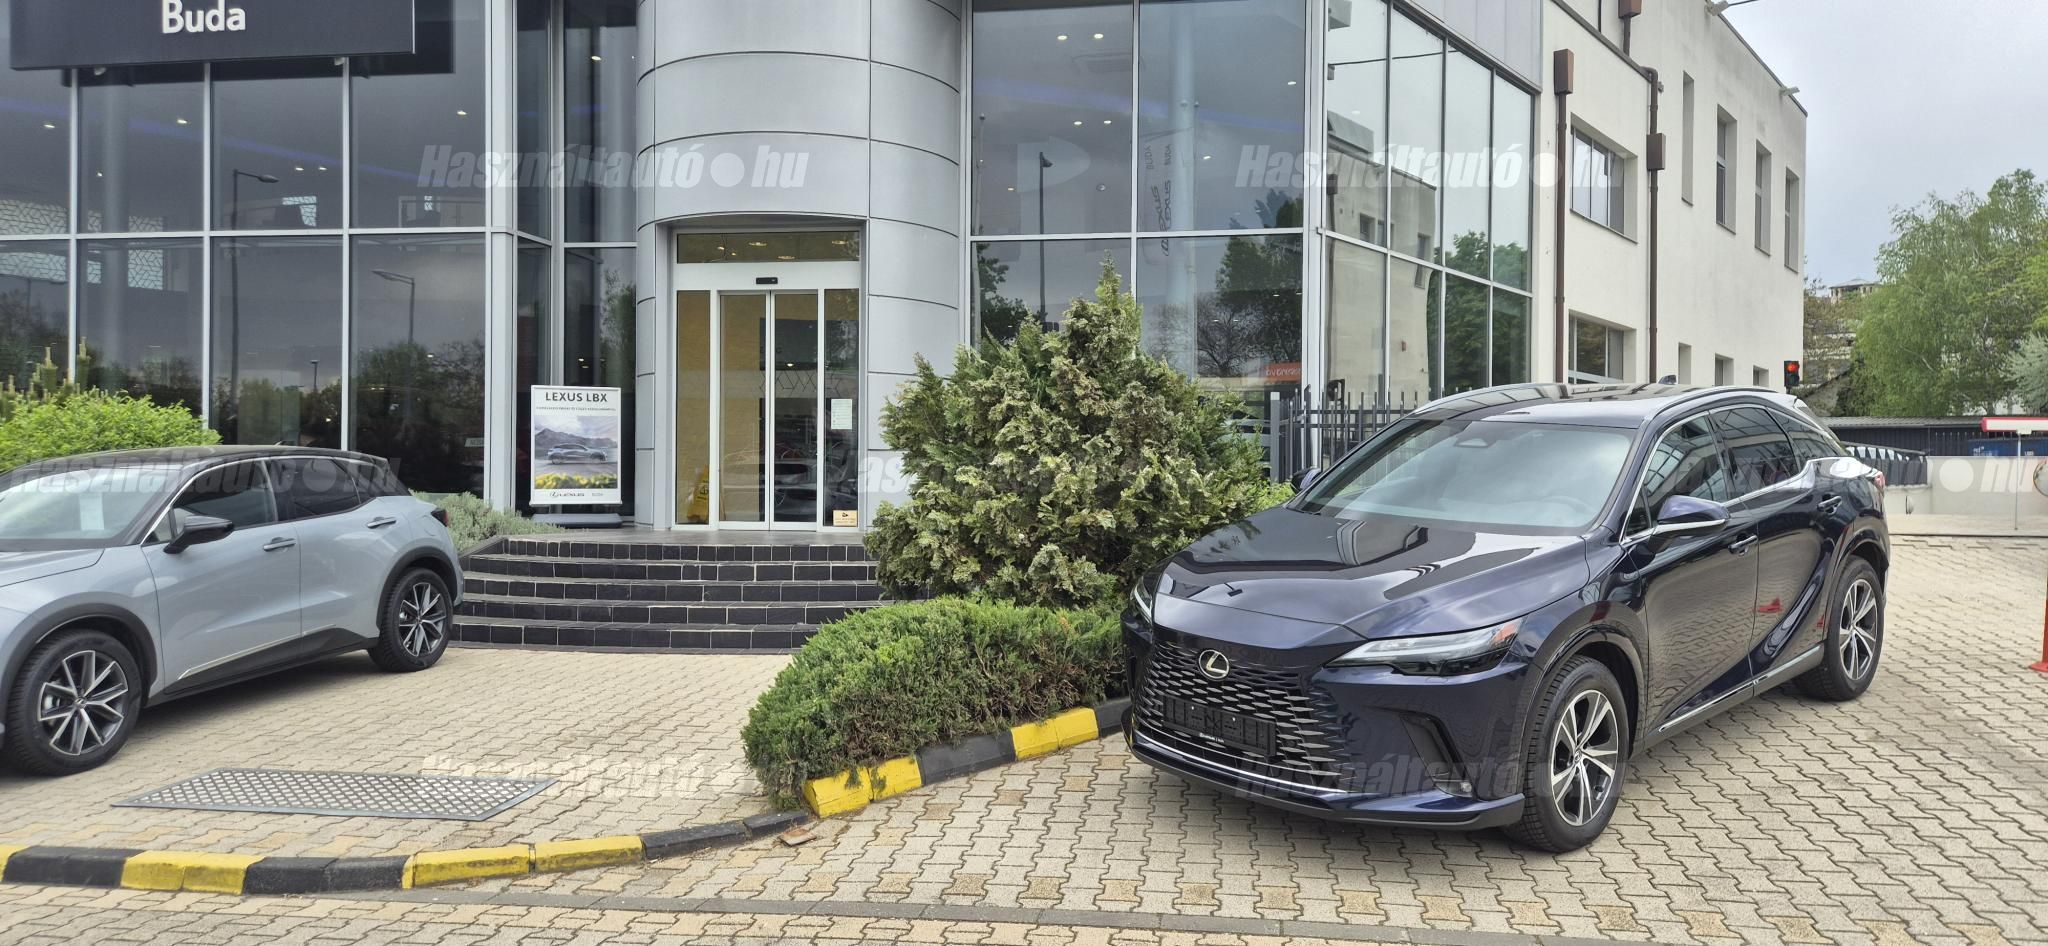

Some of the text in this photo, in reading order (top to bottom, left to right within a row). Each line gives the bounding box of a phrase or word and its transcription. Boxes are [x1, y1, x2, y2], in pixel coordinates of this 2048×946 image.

[162, 0, 246, 34] Buda
[545, 392, 608, 403] LEXUS LBX
